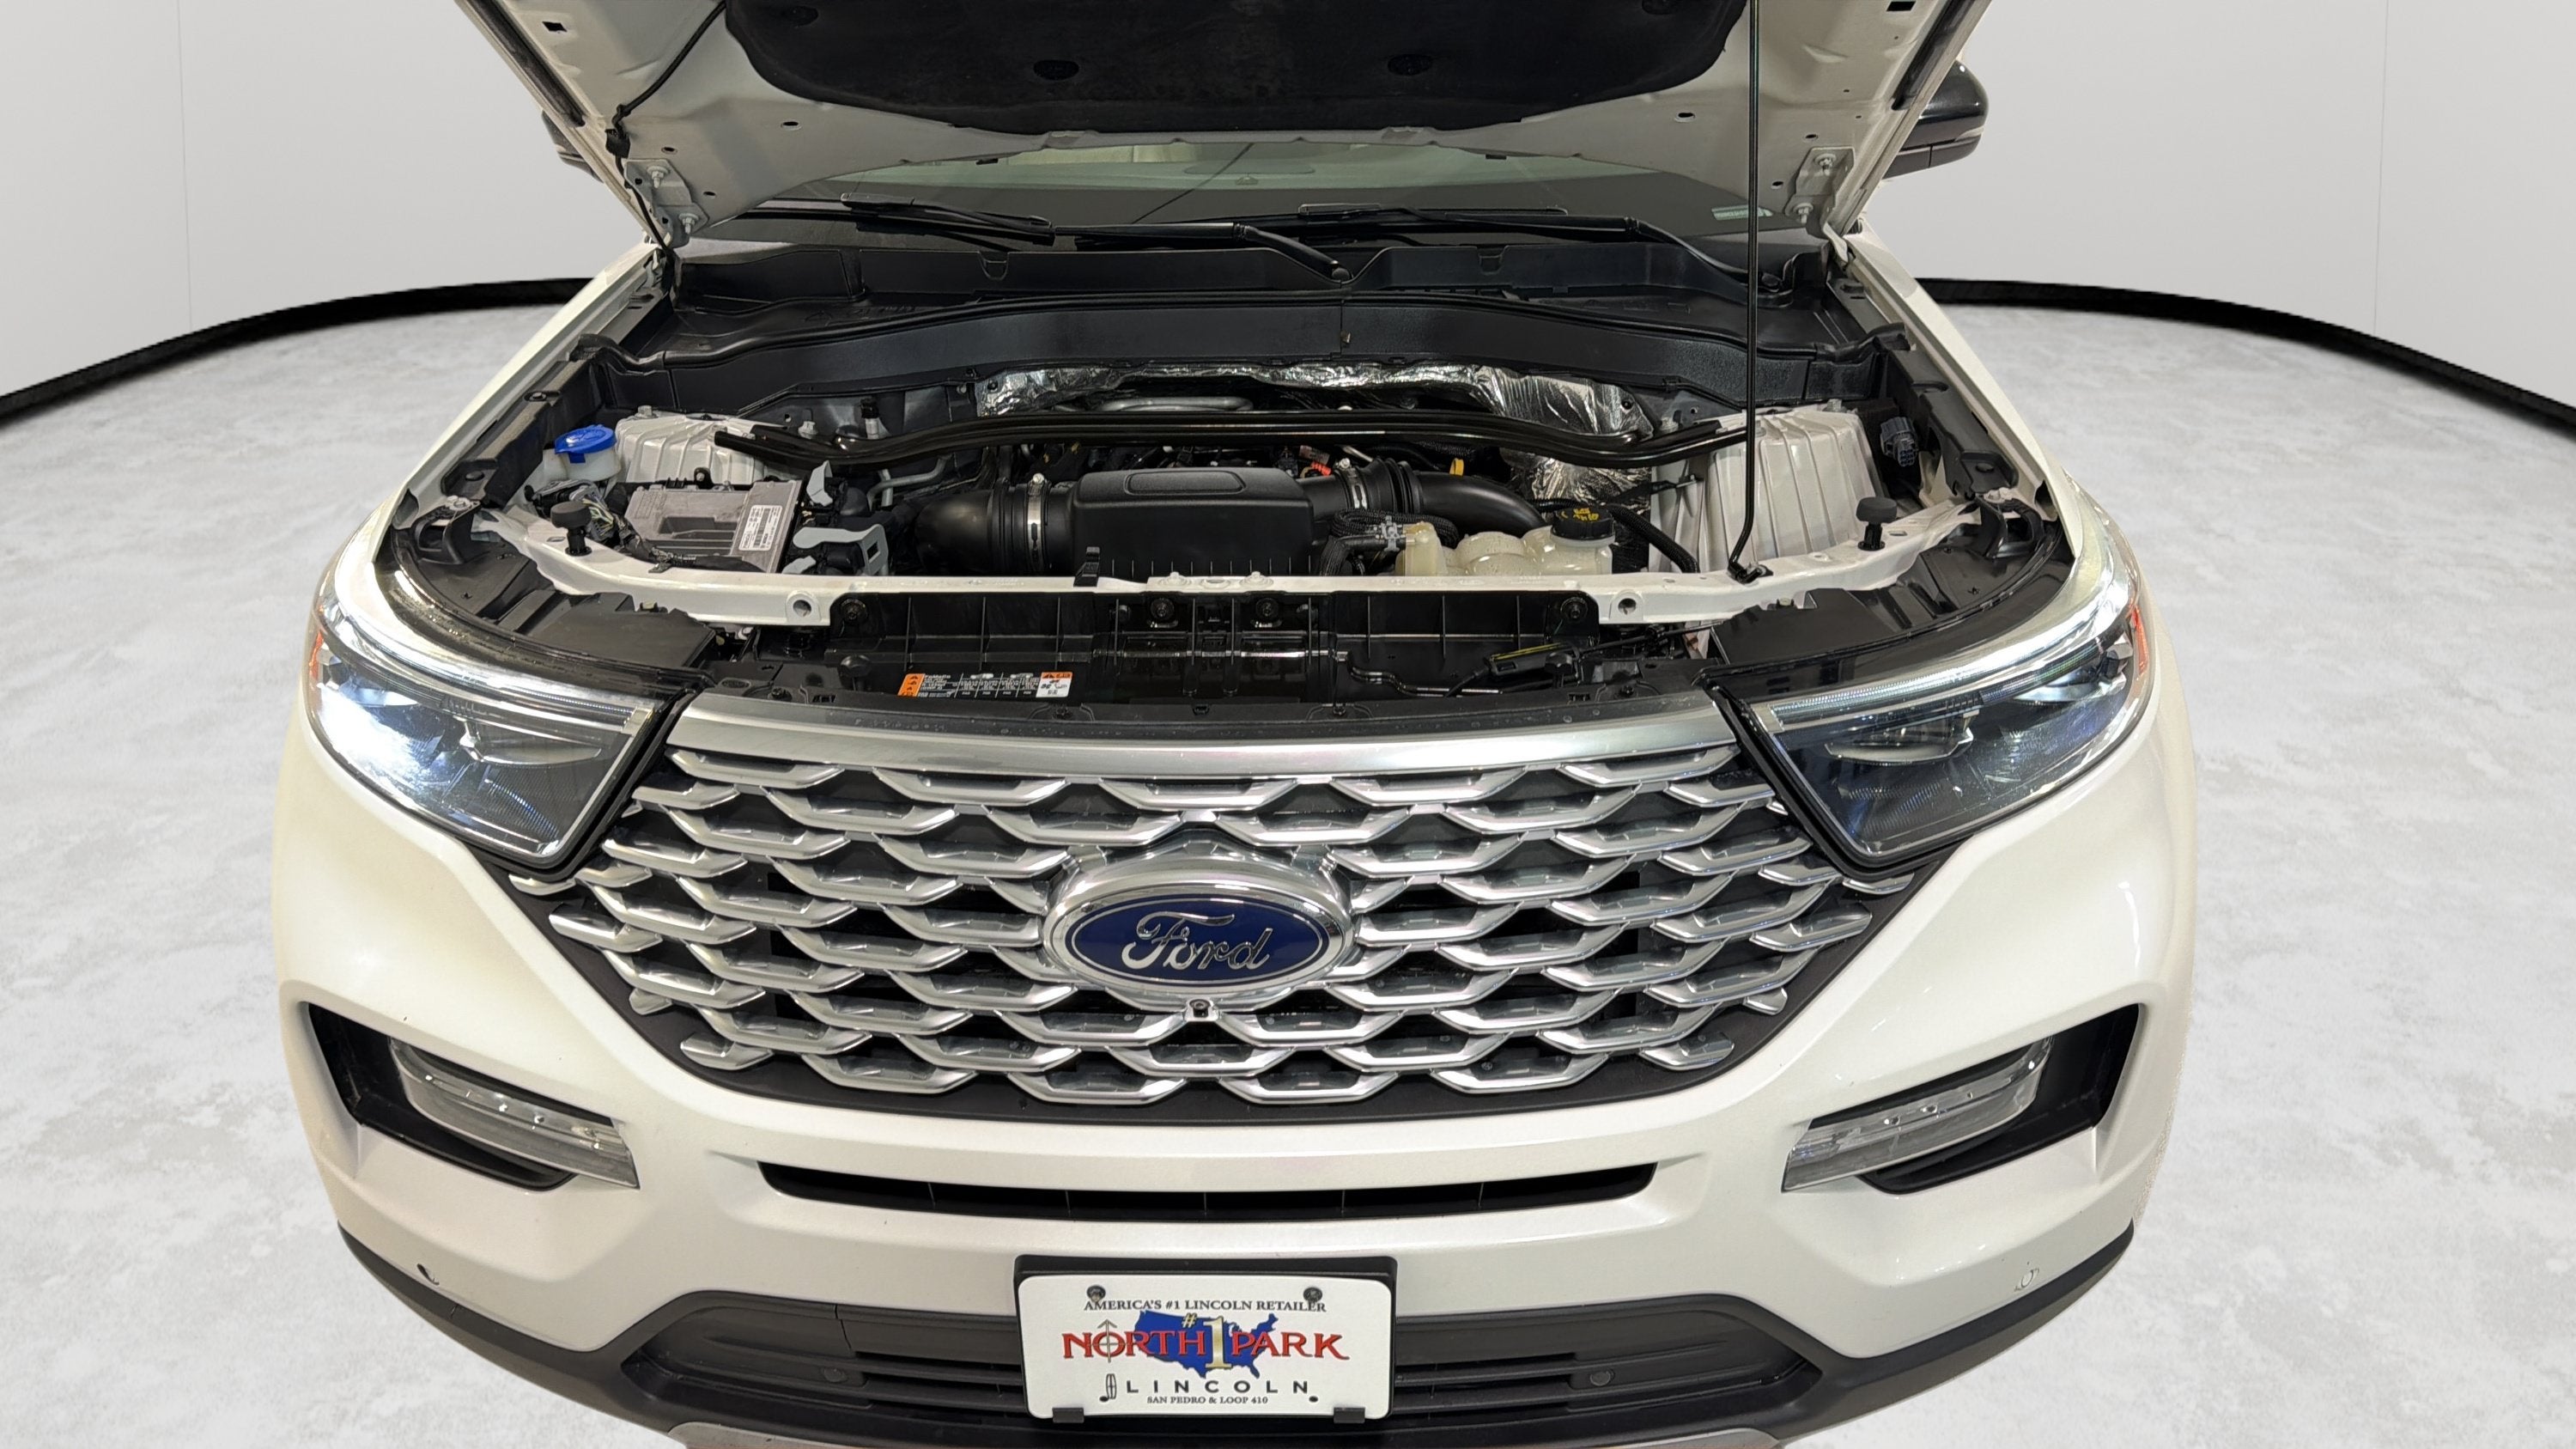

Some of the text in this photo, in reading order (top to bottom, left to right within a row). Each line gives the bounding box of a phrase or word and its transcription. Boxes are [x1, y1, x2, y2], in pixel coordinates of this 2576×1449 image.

[1121, 911, 1273, 971] Ford
[1084, 1300, 1327, 1312] AMERICA'S #1 LINCOLN RETAILER
[1061, 1330, 1351, 1361] NORTH PARK
[1127, 1380, 1308, 1394] LINCOLN
[1147, 1396, 1268, 1404] SAN PEDRO & LOOP 410
